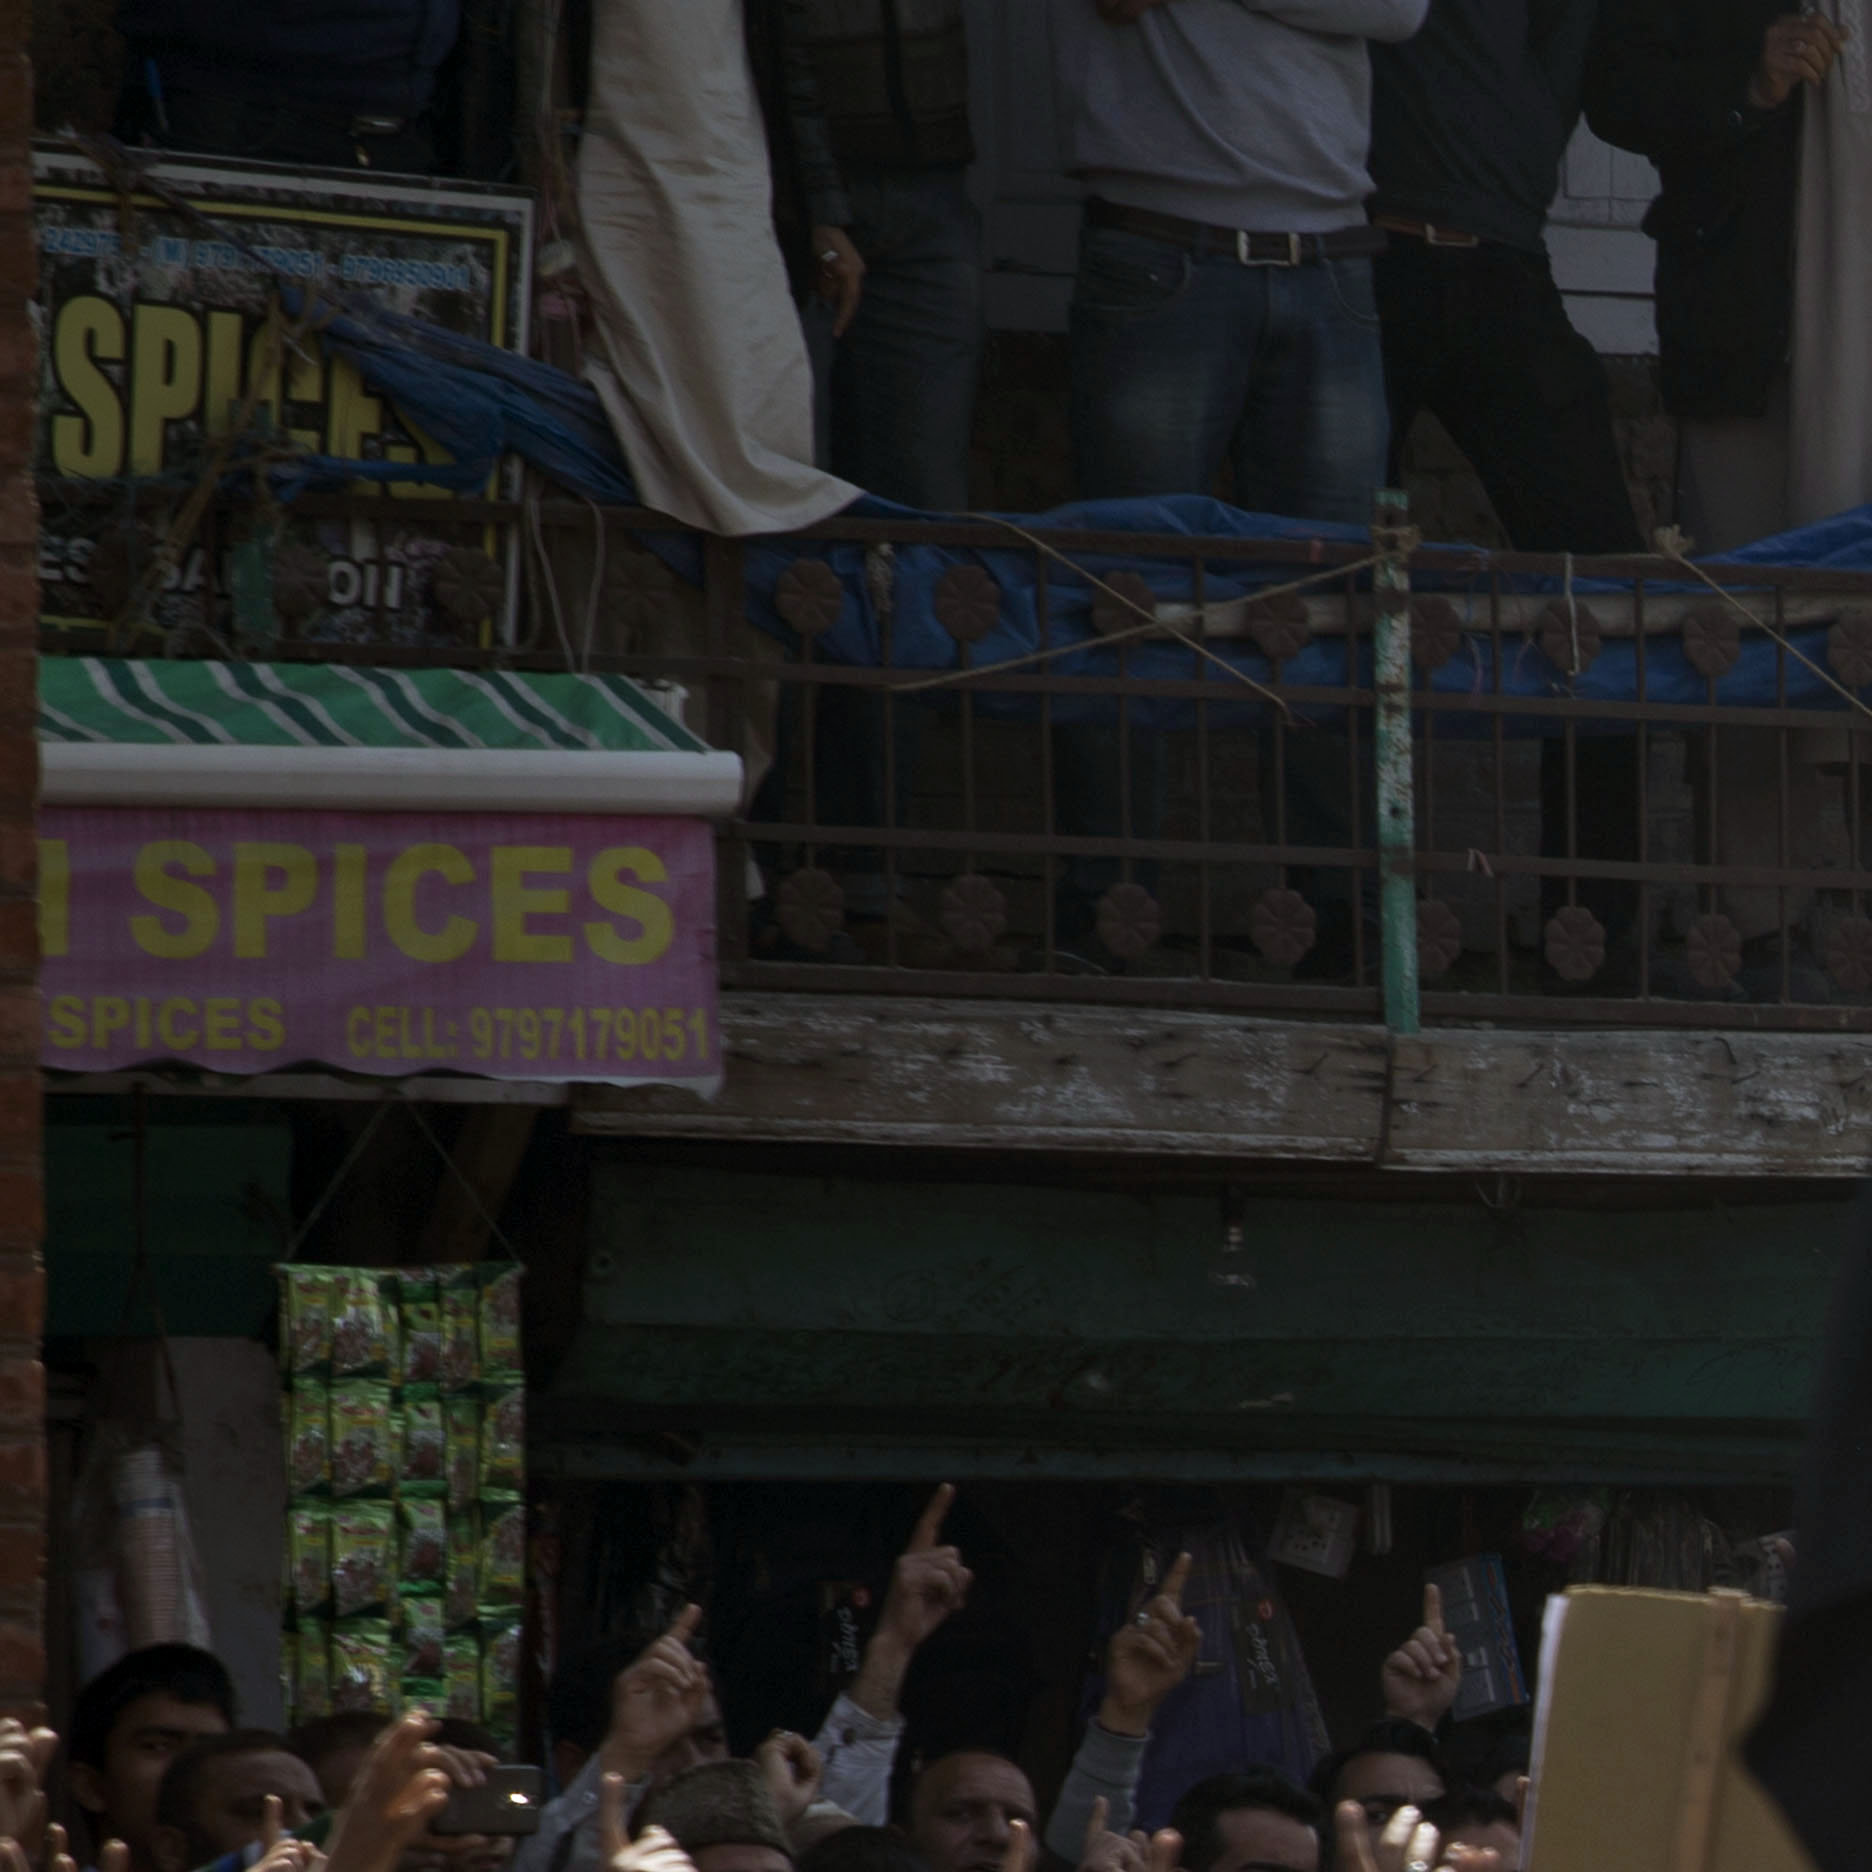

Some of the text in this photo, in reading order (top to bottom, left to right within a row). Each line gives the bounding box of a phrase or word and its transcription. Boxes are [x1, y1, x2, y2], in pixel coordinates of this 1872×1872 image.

[129, 838, 675, 966] SPICES
[48, 994, 709, 1062] SPICES CELL: 9797179051
